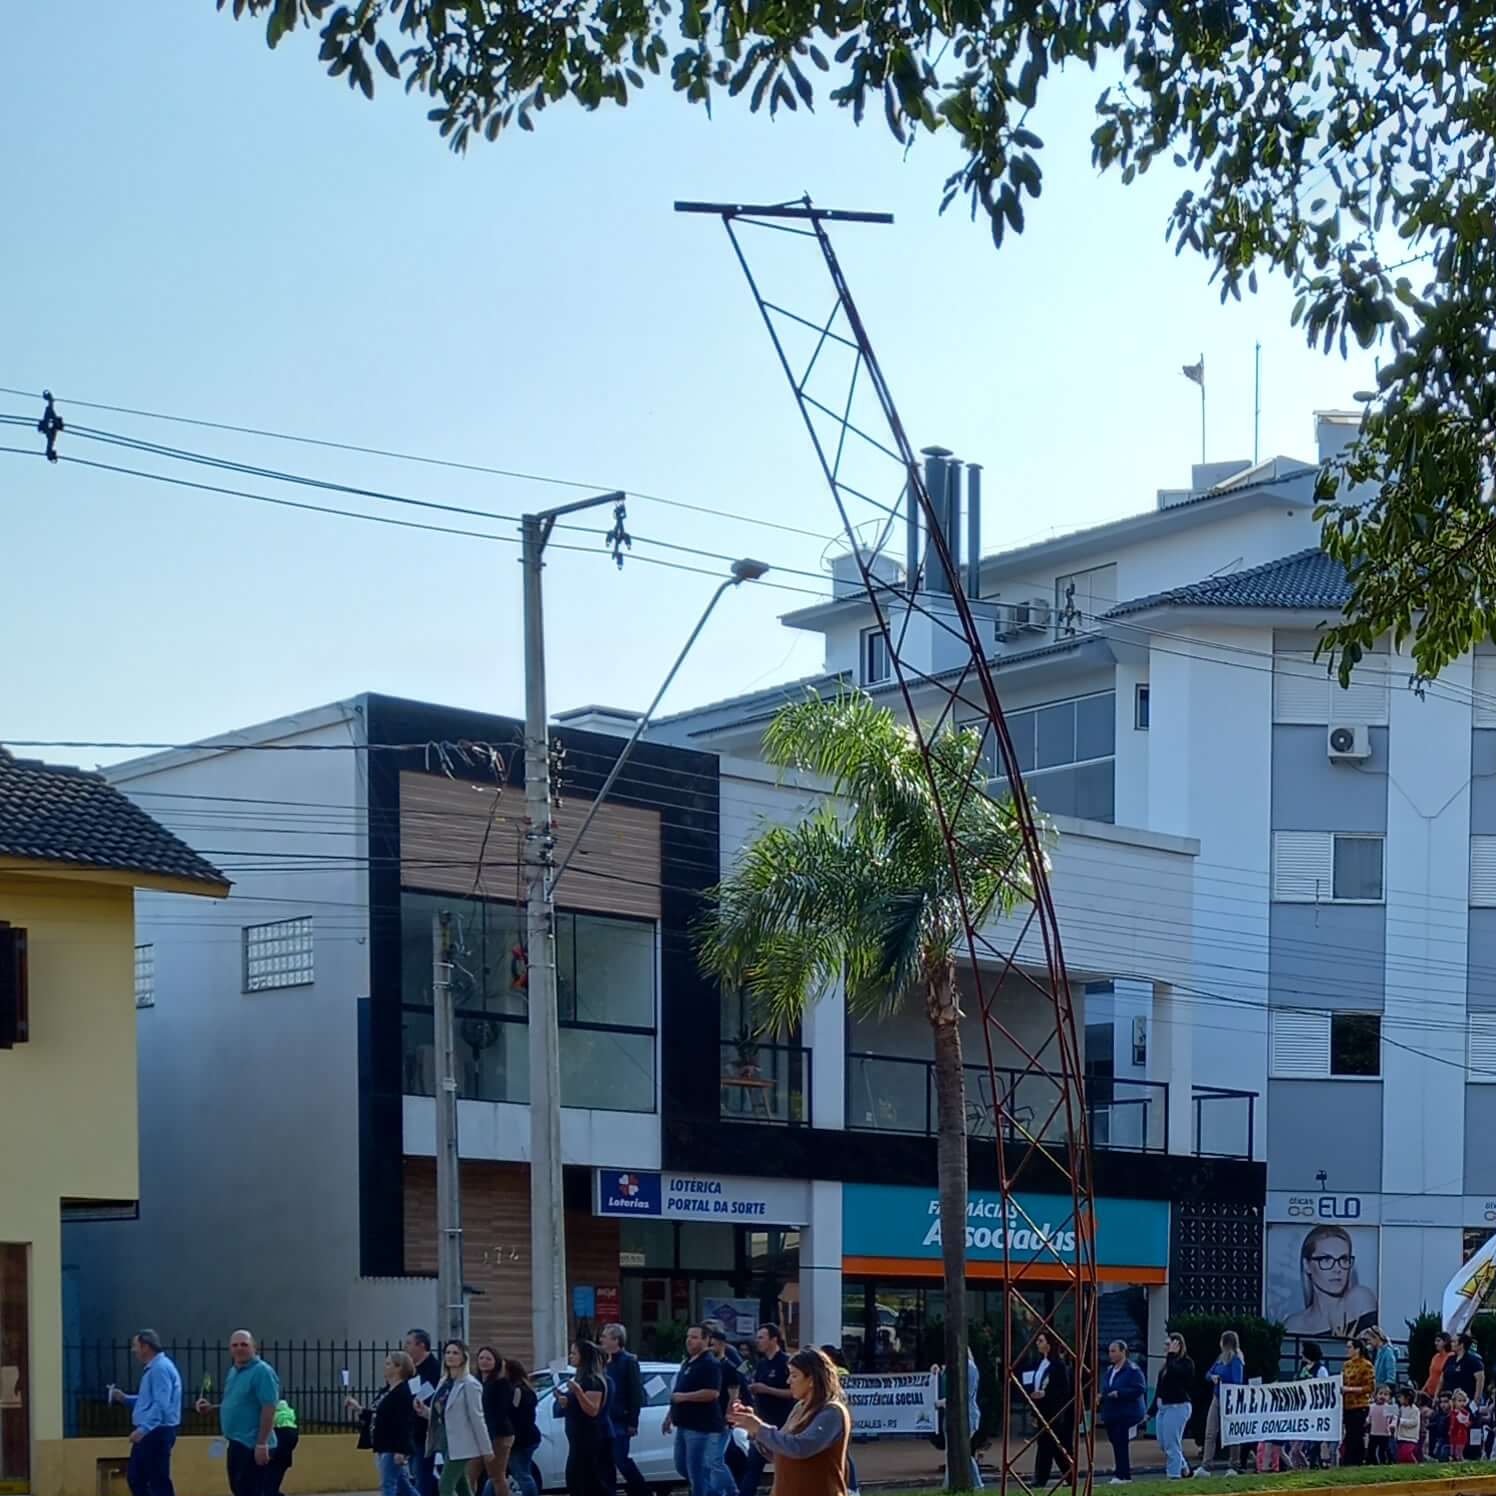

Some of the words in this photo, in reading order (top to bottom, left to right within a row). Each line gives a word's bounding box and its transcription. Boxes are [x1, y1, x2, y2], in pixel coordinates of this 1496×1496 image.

[670, 1177, 721, 1194] LOTÉRICA
[608, 1196, 650, 1209] Loterias
[667, 1198, 710, 1212] PORTAL
[713, 1200, 729, 1213] DA
[731, 1201, 766, 1215] SORTE
[1318, 1196, 1361, 1218] ELO
[1268, 1385, 1307, 1412] MENINO
[1309, 1382, 1336, 1409] JESUS
[1229, 1421, 1258, 1436] ROQUE
[1261, 1418, 1310, 1433] GONZALES
[1316, 1417, 1331, 1431] RS
